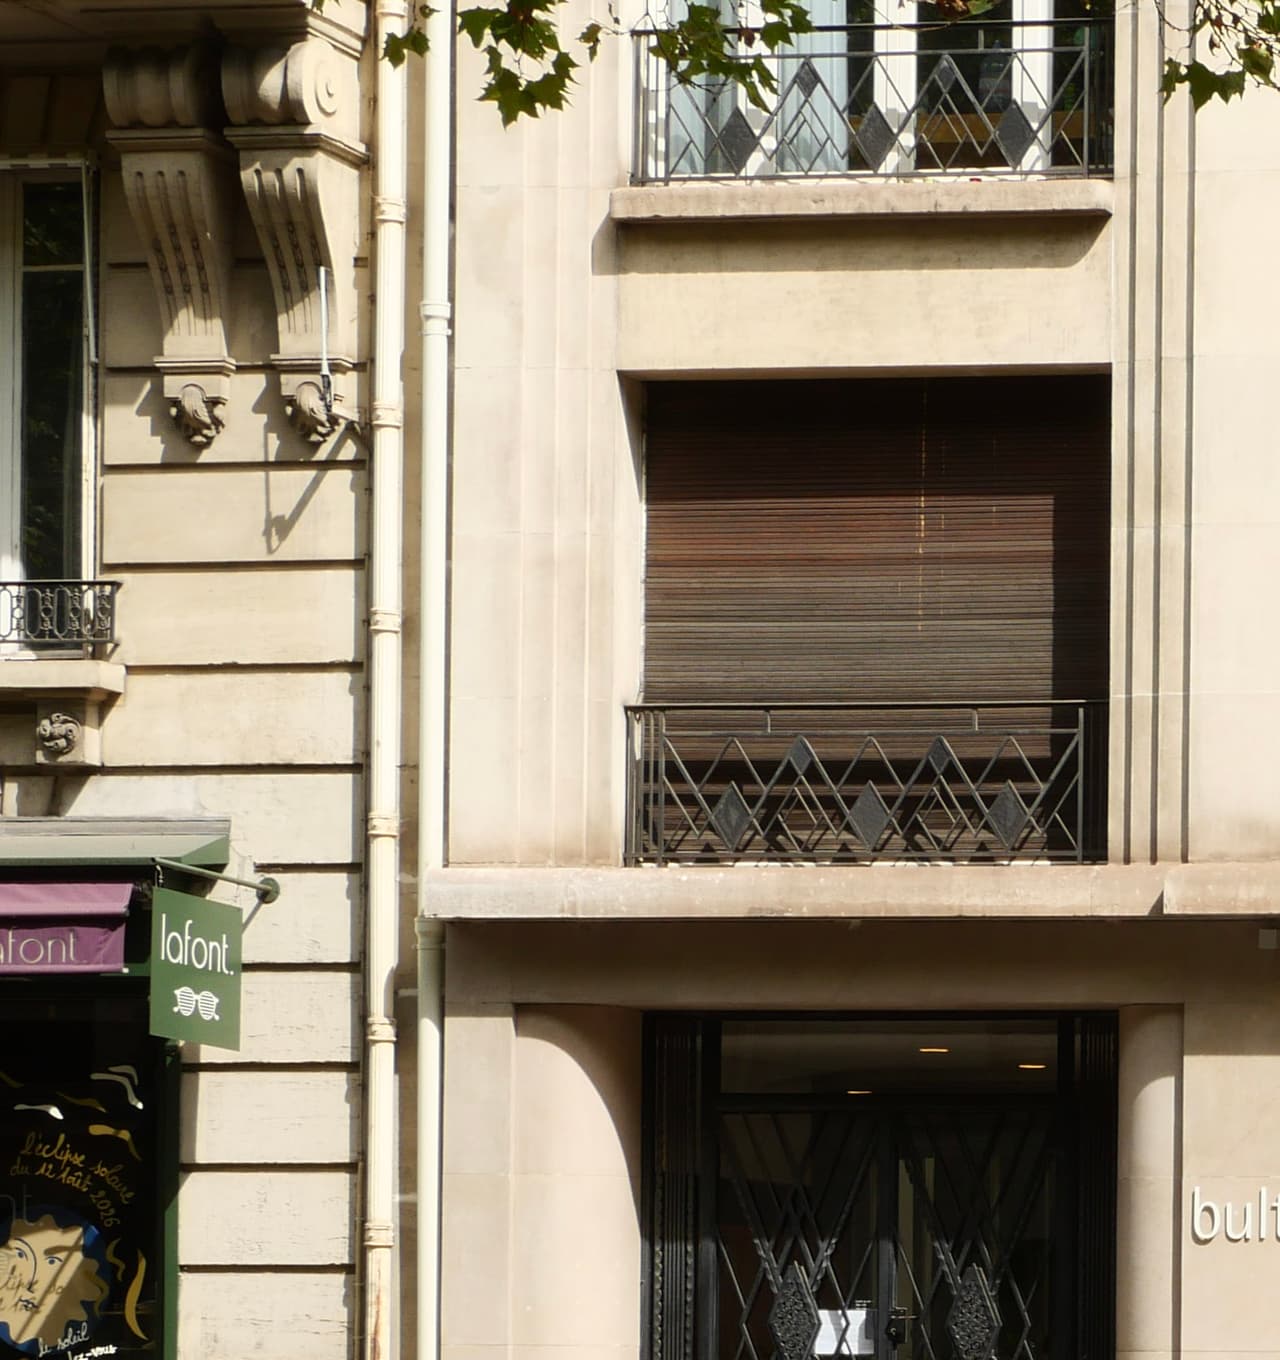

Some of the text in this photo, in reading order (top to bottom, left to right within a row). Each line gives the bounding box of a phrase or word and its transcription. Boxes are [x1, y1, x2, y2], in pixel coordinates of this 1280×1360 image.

[9, 1156, 31, 1176] du
[34, 1162, 56, 1179] 12
[89, 1190, 121, 1227] 2026
[57, 1322, 90, 1350] soleil
